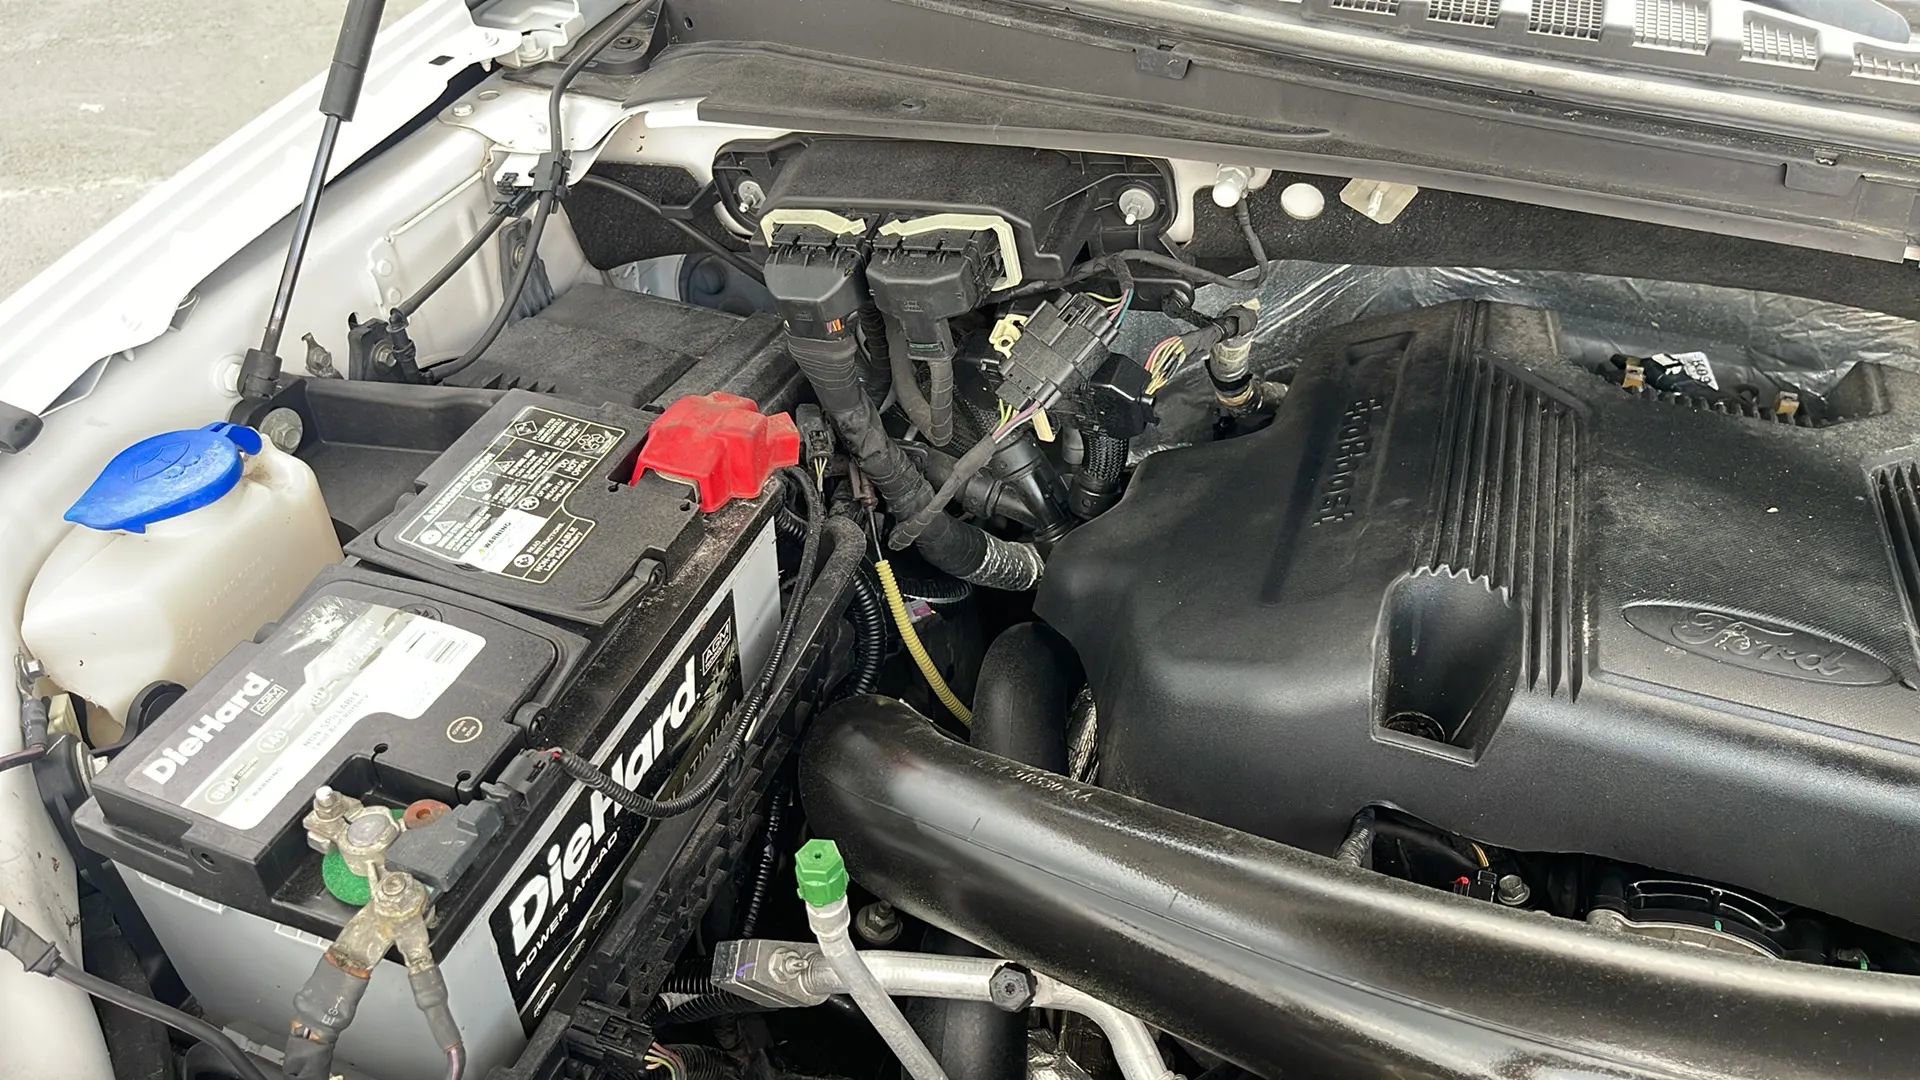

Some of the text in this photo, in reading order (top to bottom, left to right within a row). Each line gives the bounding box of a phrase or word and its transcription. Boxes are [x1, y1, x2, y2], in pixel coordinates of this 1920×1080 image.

[558, 458, 570, 467] DO
[563, 458, 580, 472] NOT
[484, 521, 512, 547] WARNING
[532, 526, 580, 572] NON-SPILLABLE
[705, 624, 729, 663] AGM
[1671, 612, 1848, 676] Ford
[142, 671, 273, 782] DieHard
[516, 829, 617, 981] POWER AHEAD
